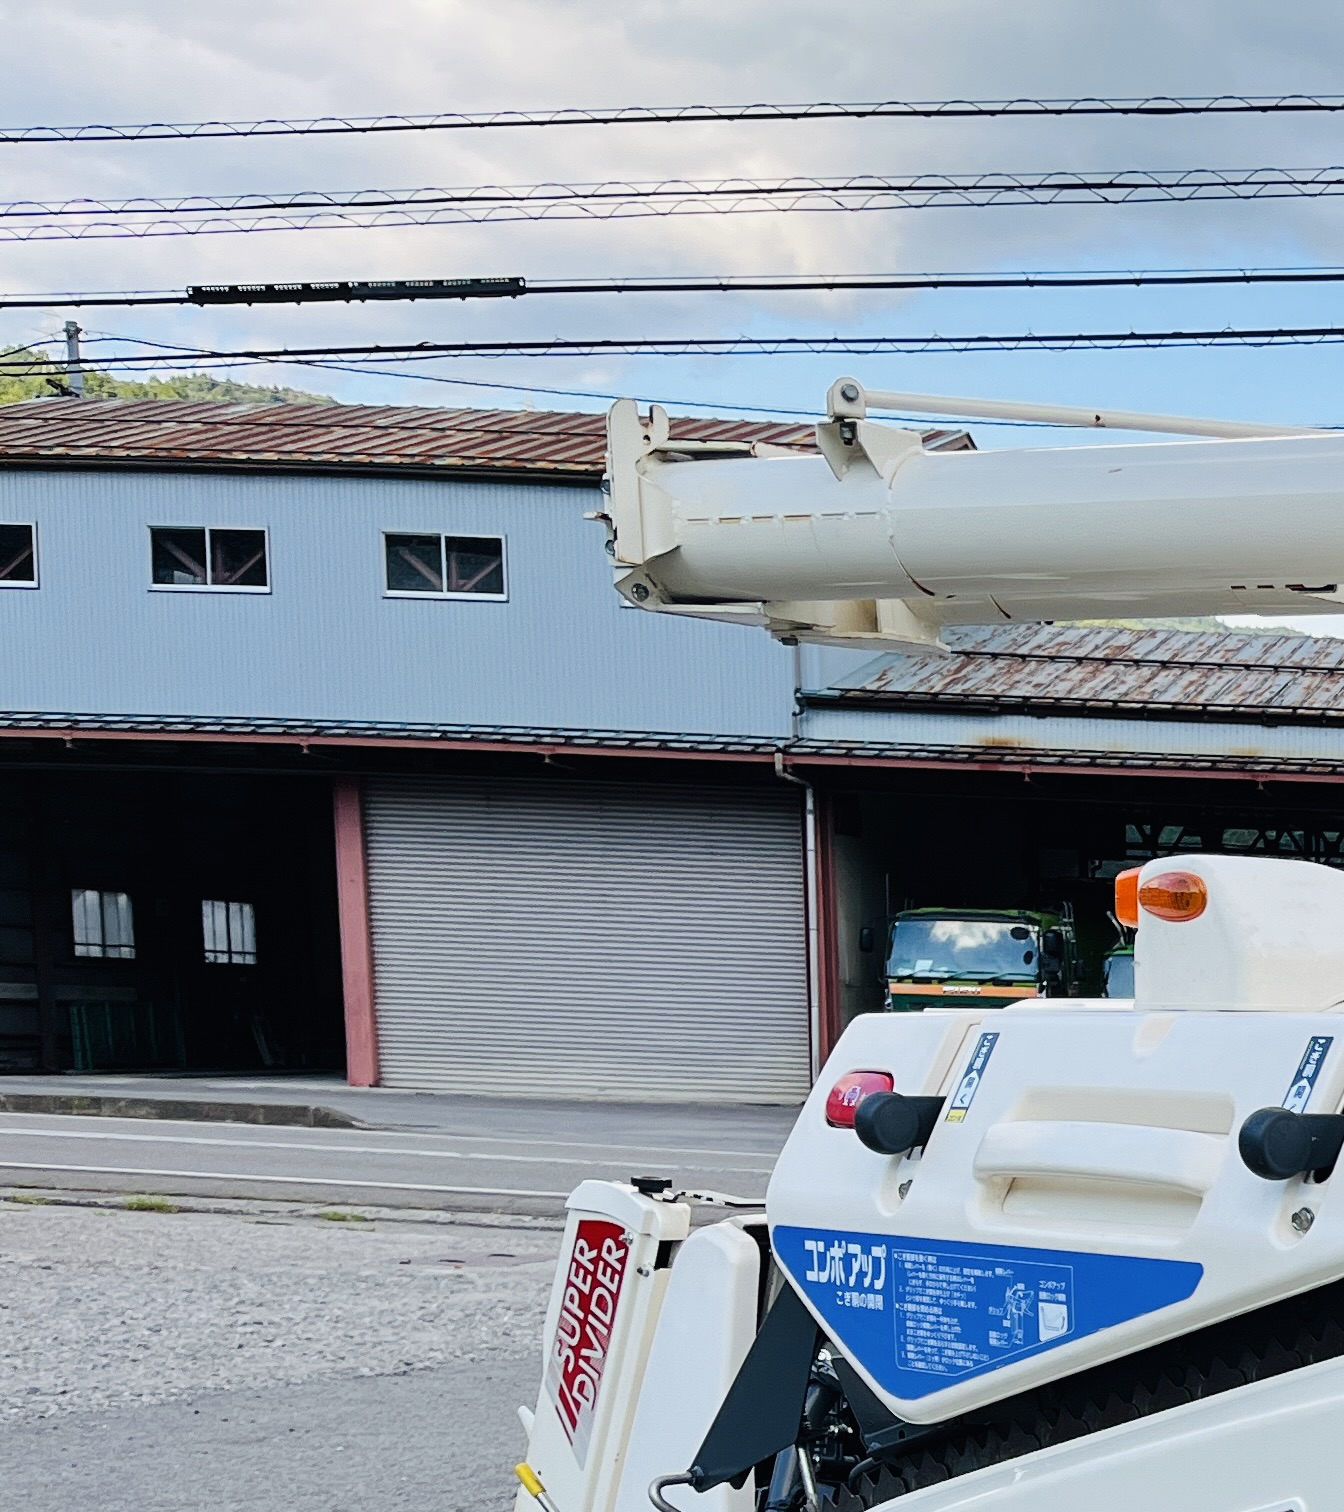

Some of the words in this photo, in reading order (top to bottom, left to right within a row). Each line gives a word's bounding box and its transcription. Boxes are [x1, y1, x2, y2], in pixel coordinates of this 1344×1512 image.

[554, 1238, 599, 1374] SUPER
[571, 1237, 629, 1411] DIVIDER
[804, 1239, 887, 1290] コンポアップ
